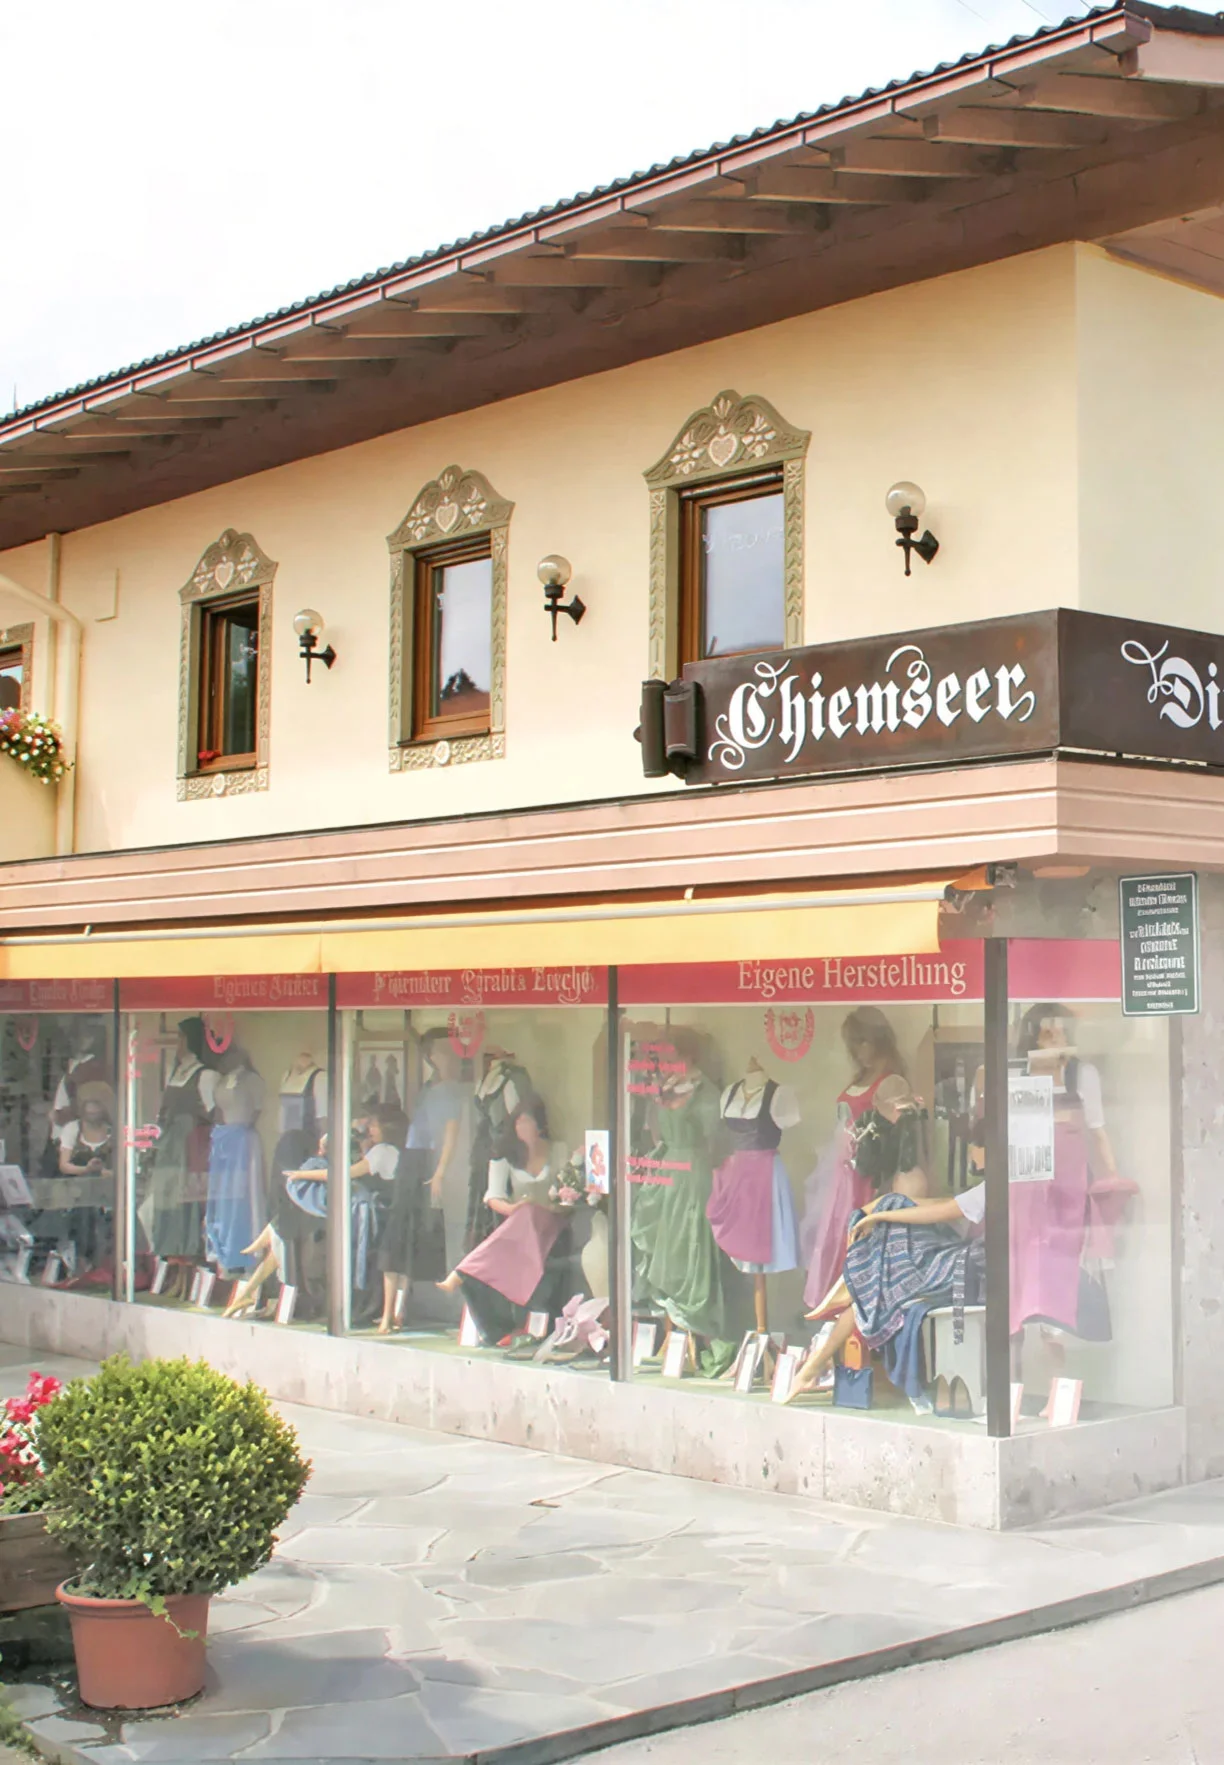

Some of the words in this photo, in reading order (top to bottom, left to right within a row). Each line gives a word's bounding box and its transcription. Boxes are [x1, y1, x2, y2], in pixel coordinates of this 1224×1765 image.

[708, 644, 1035, 770] Chiemseer
[737, 960, 814, 998] Eigene
[822, 955, 967, 995] Herstellung
